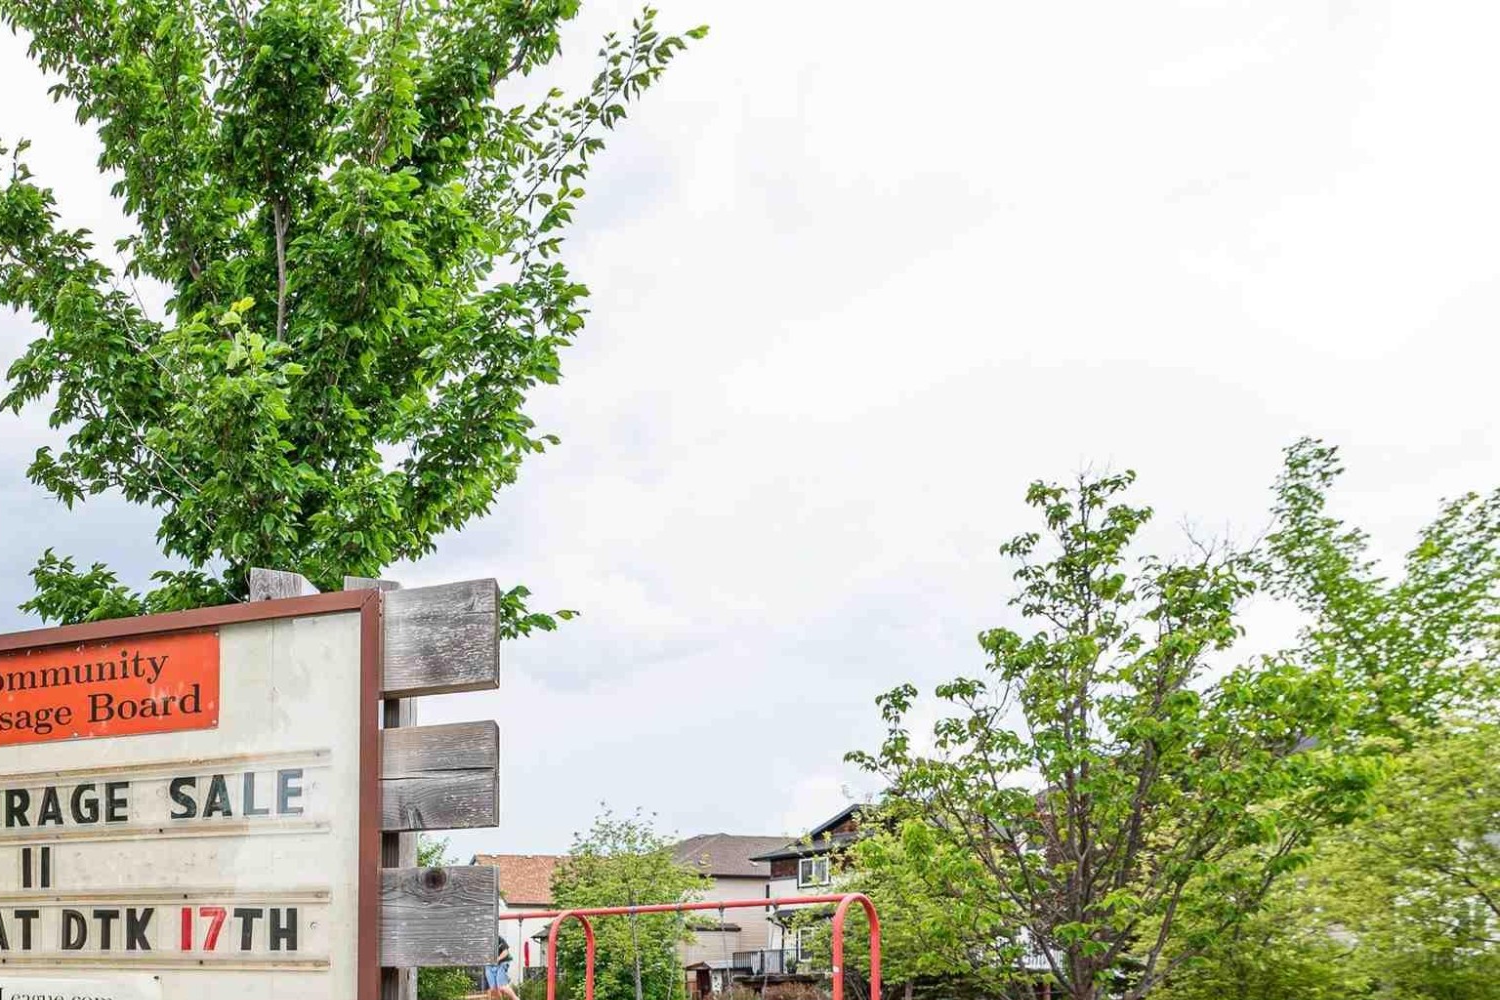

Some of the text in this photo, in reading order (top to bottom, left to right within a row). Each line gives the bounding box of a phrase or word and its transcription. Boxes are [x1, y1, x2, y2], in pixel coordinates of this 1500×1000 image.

[88, 684, 202, 723] Board
[169, 768, 304, 820] SALE
[22, 847, 51, 889] 11
[62, 908, 155, 951] DTK
[181, 906, 298, 952] 17TH
